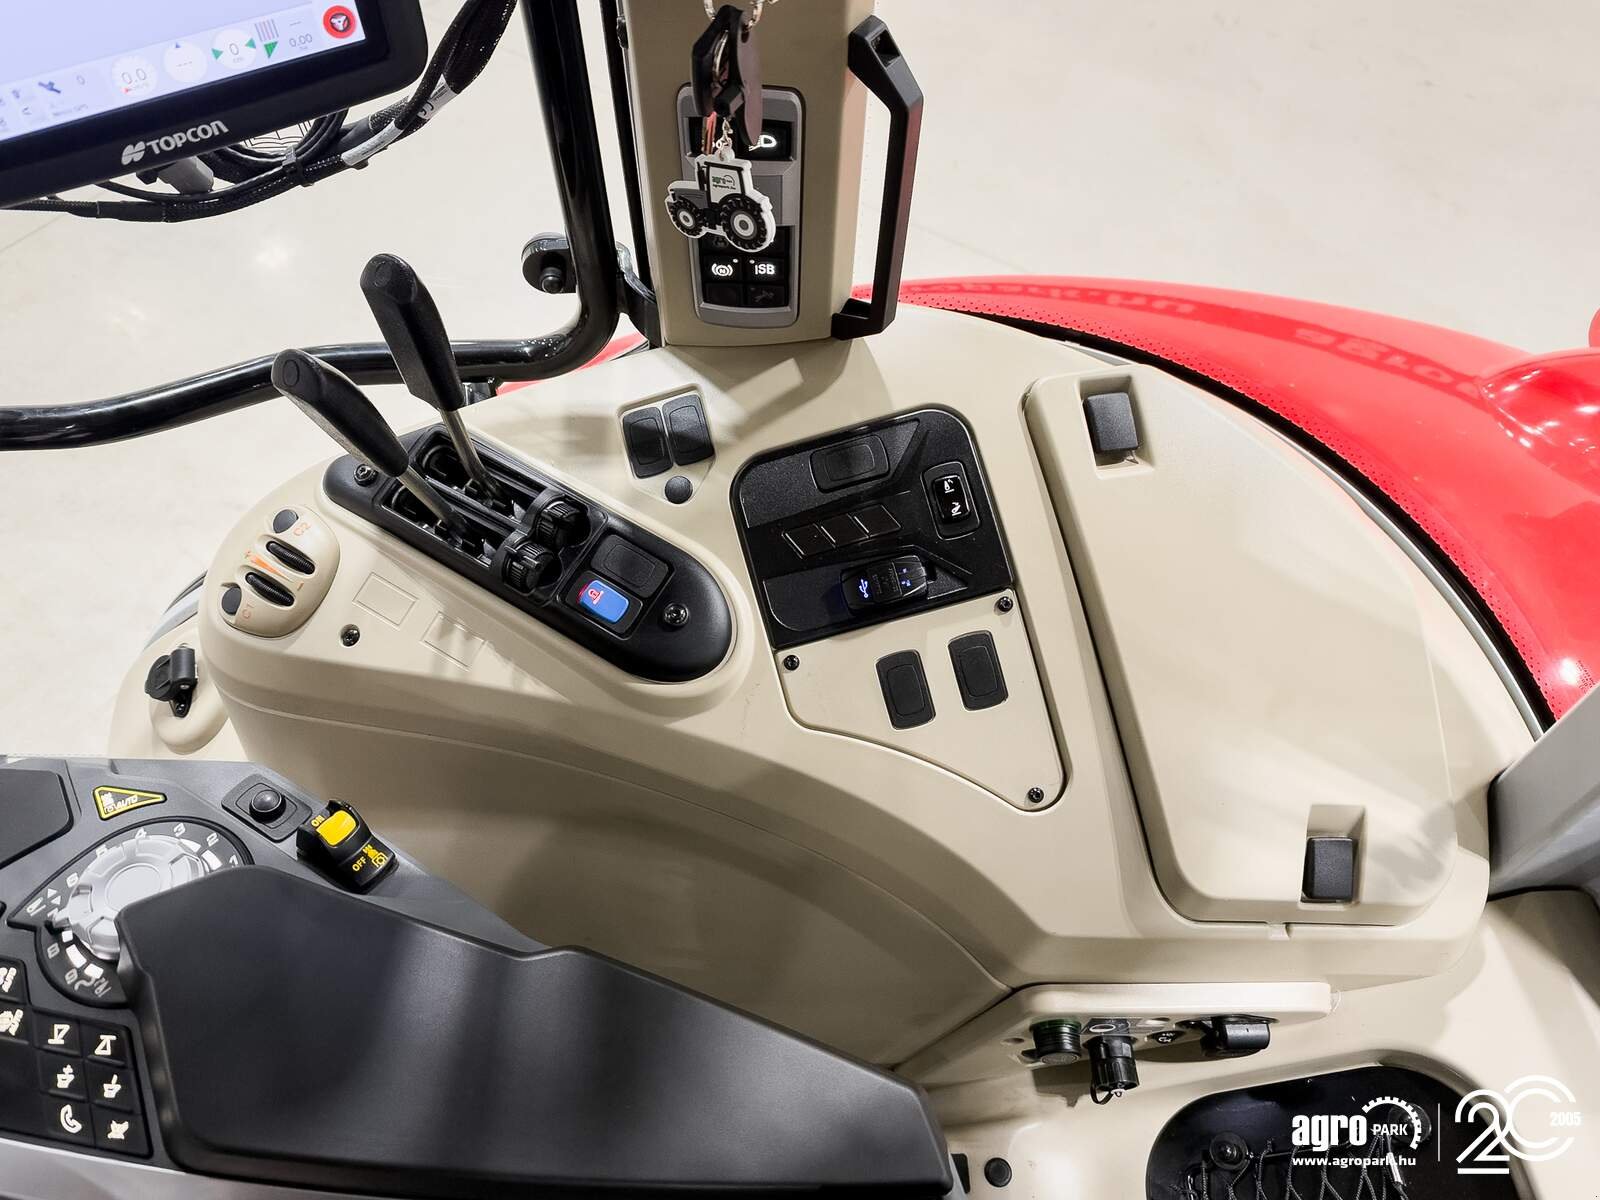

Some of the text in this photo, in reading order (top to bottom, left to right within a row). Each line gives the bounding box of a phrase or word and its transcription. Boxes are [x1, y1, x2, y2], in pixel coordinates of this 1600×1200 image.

[754, 264, 776, 276] ISB
[311, 814, 326, 828] ON
[352, 856, 366, 872] OFF
